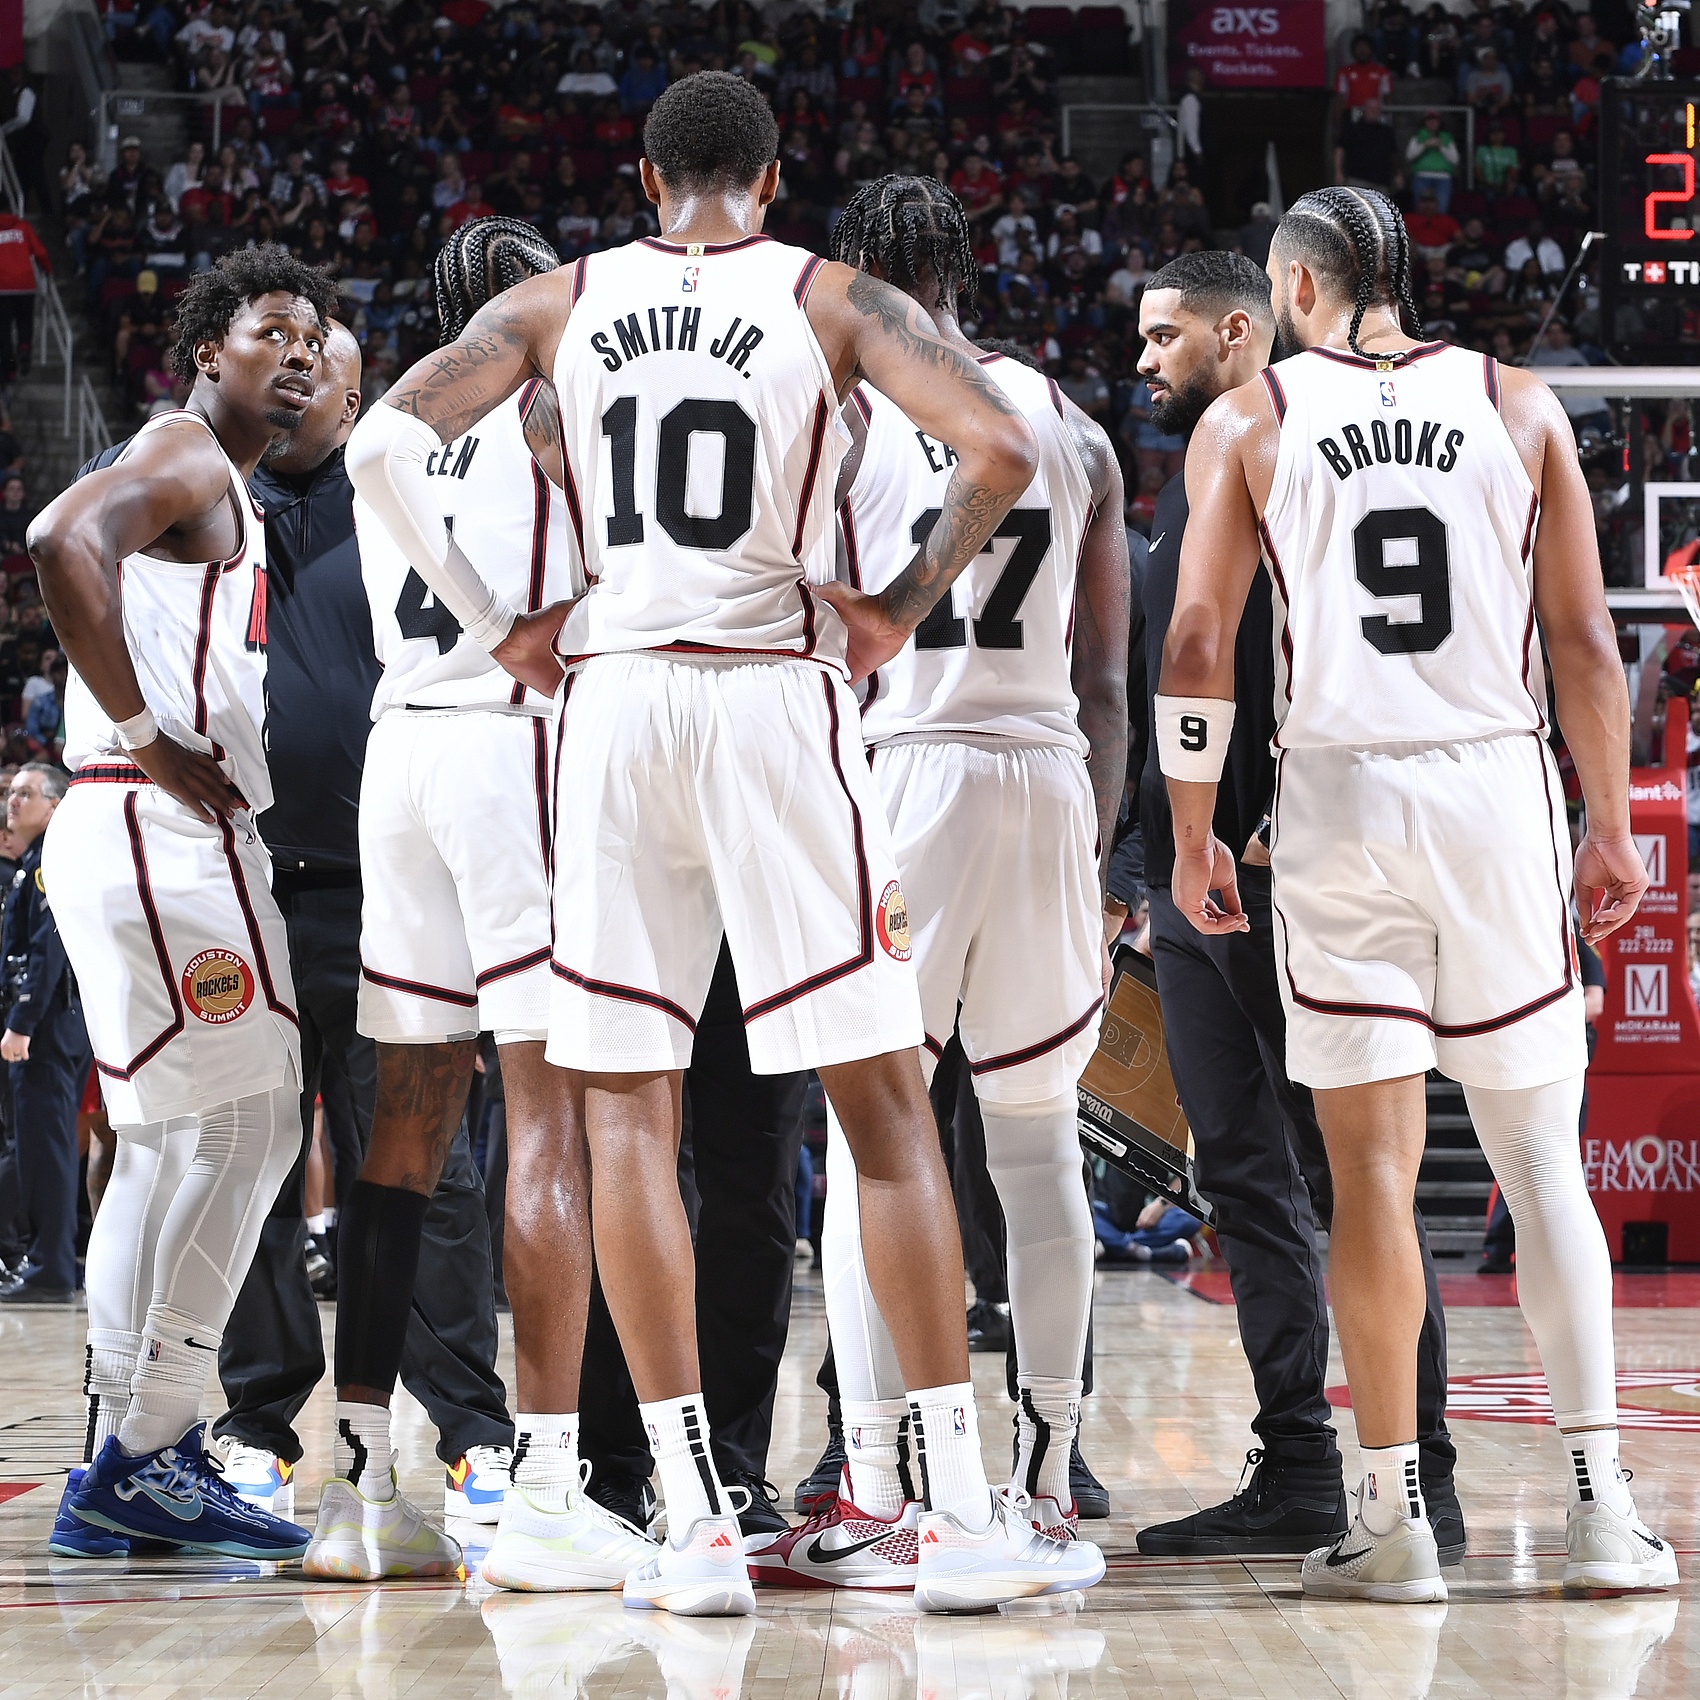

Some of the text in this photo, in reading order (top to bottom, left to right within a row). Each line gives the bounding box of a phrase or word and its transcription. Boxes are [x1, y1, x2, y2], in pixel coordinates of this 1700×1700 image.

[1211, 7, 1280, 38] axs
[1645, 154, 1695, 239] 2
[591, 306, 764, 379] SMITH JR.
[600, 395, 758, 551] 10
[1317, 419, 1464, 481] BROOKS
[1350, 505, 1454, 657] 9
[1180, 716, 1207, 751] 9
[184, 951, 243, 978] HOUSTON
[1619, 939, 1673, 953] 222-2222
[199, 1001, 245, 1022] SUMMIT
[1629, 966, 1663, 1013] M
